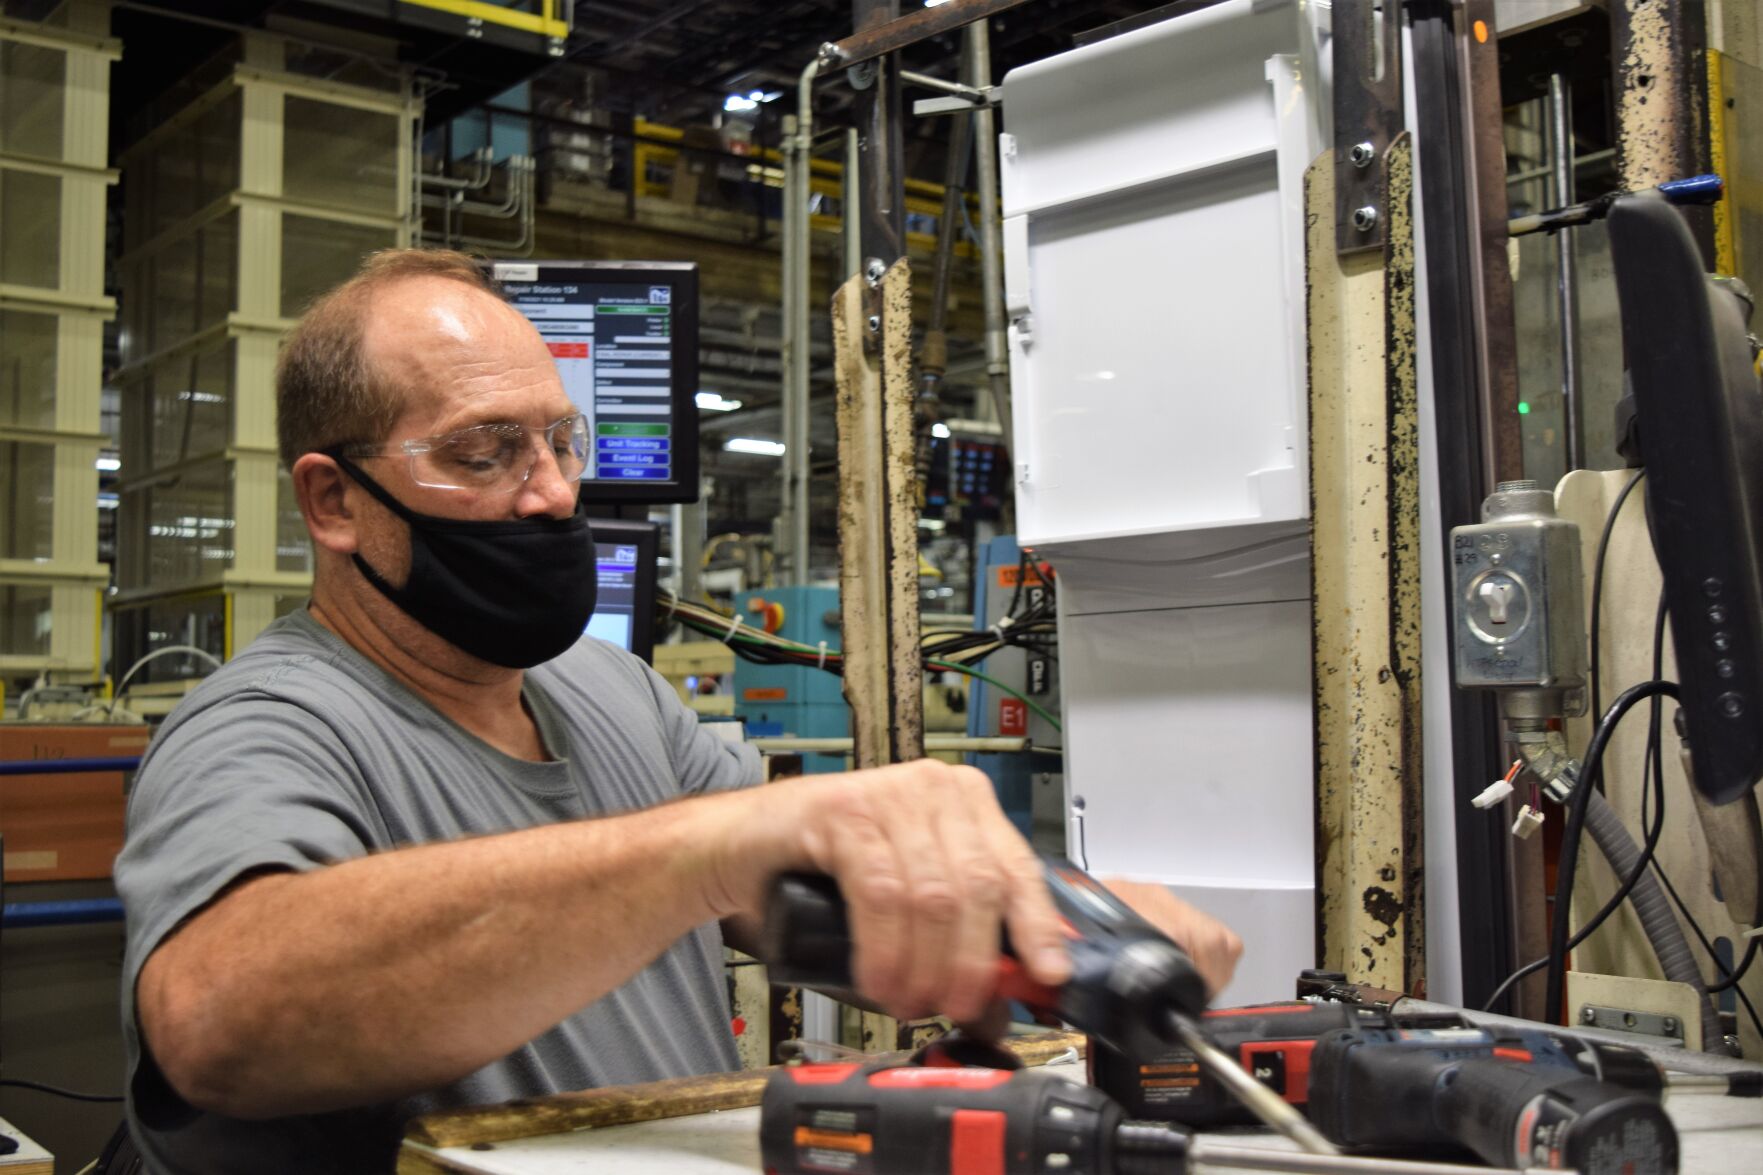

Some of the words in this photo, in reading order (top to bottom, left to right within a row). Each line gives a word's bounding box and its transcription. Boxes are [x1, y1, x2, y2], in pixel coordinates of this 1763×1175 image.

[533, 285, 562, 294] Station
[606, 440, 624, 448] Unit
[625, 440, 660, 450] Tracking
[613, 454, 636, 462] Event
[638, 454, 655, 464] Log
[1002, 705, 1024, 727] E1
